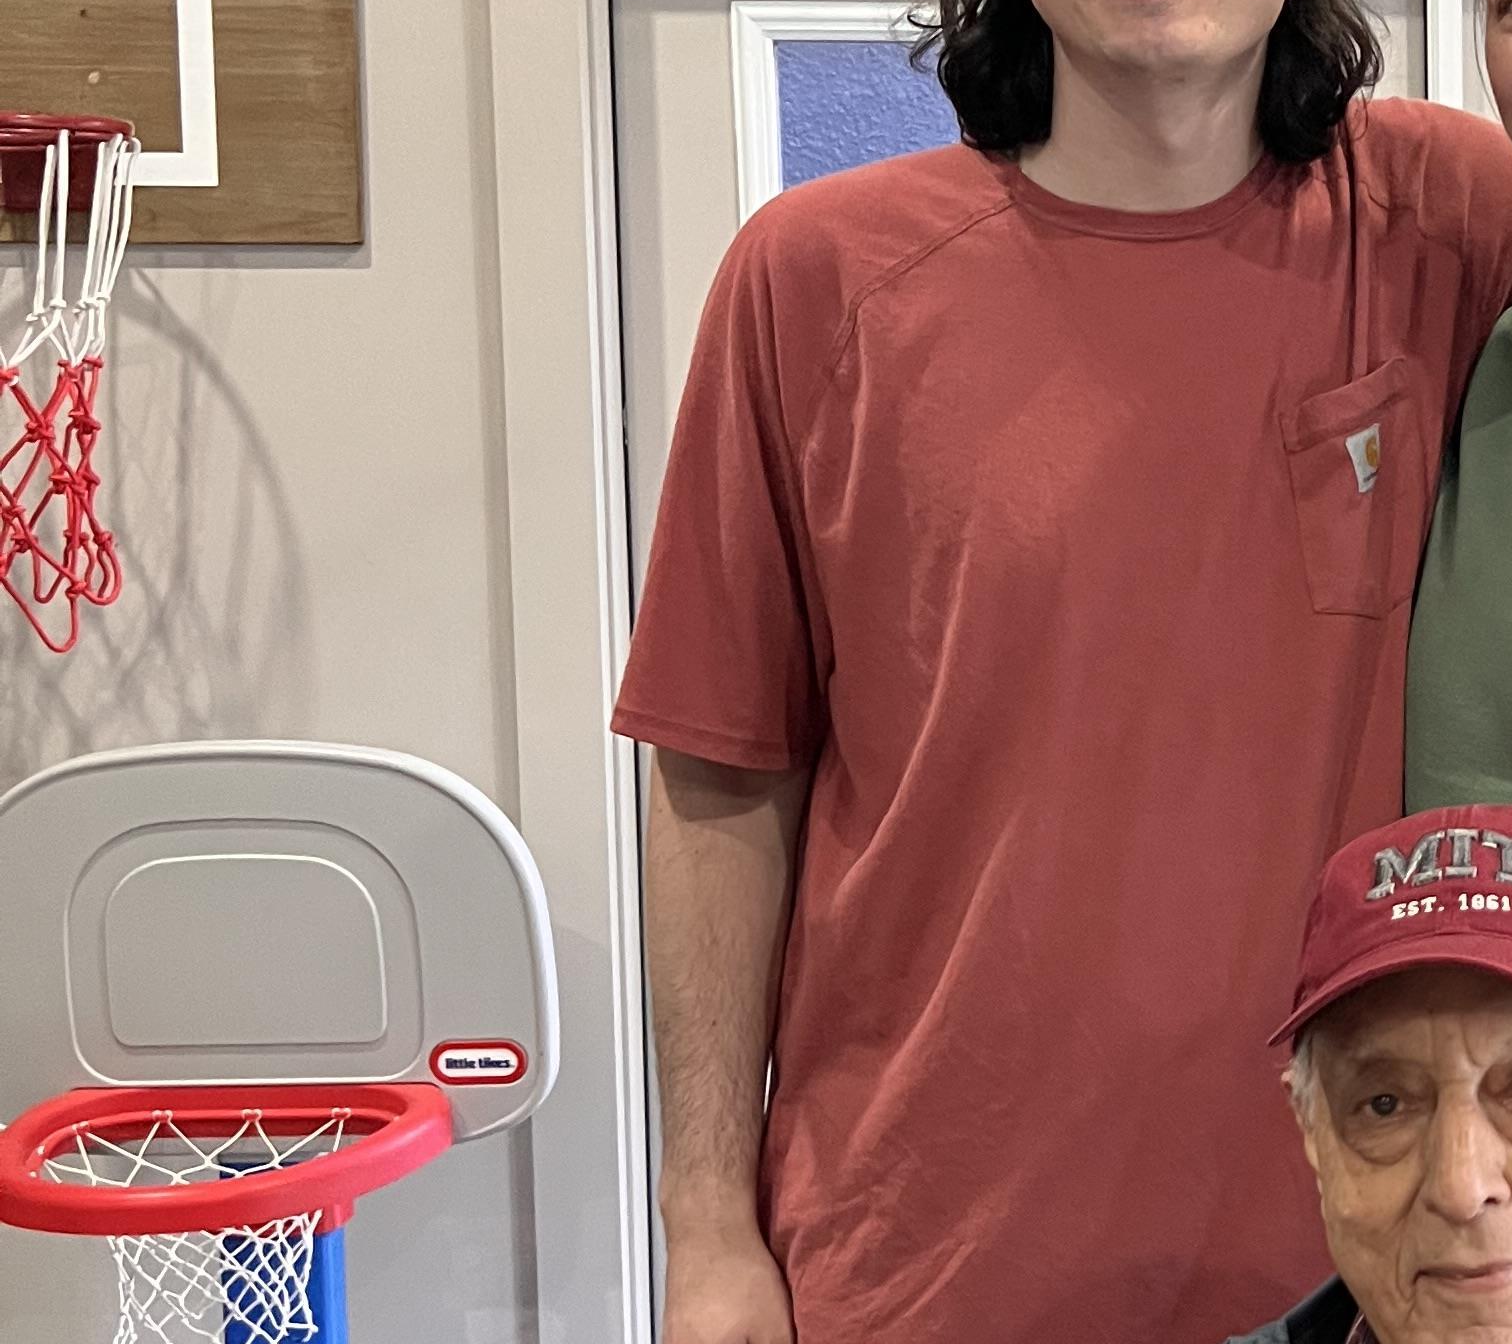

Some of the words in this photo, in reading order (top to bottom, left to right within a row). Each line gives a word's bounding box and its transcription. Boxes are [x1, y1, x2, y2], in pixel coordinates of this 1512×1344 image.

[1390, 896, 1445, 921] EST.
[1457, 892, 1512, 912] 1861
[445, 1057, 476, 1069] little
